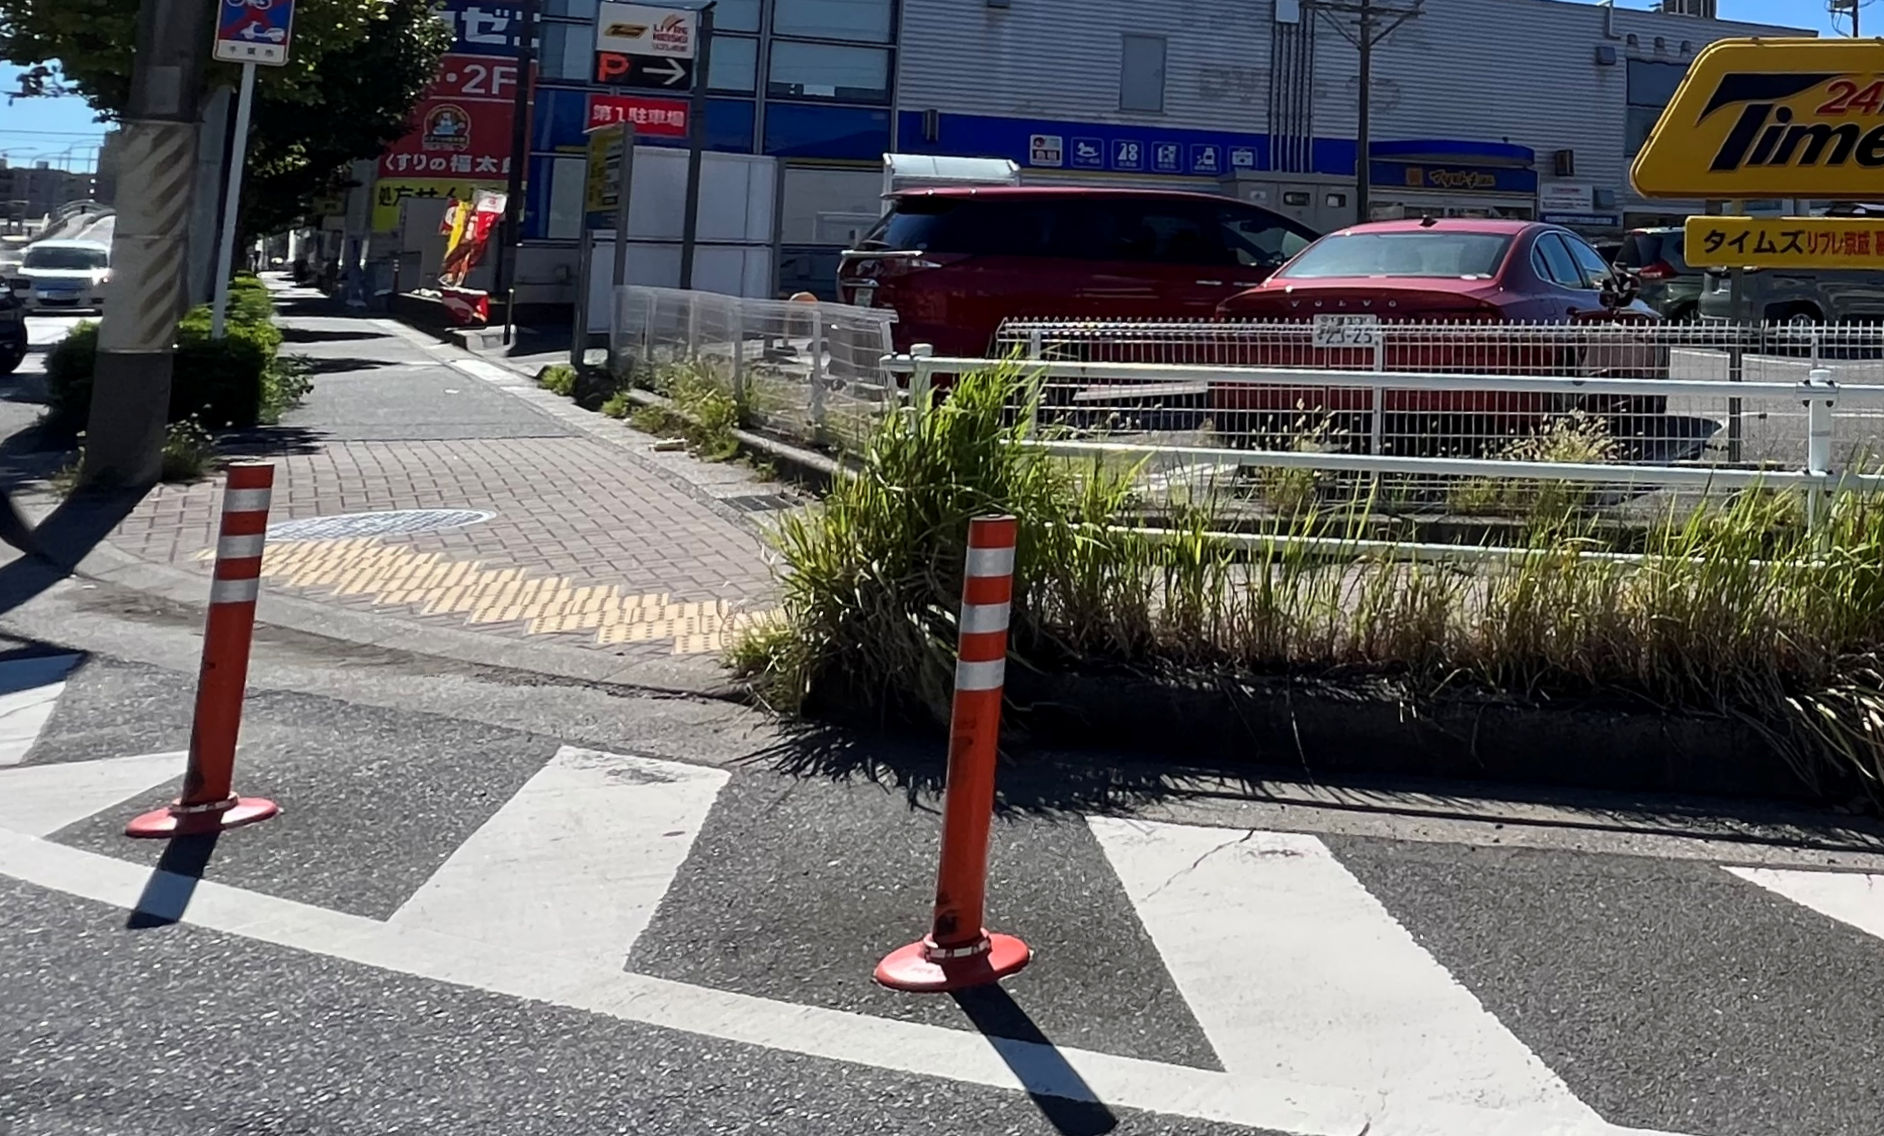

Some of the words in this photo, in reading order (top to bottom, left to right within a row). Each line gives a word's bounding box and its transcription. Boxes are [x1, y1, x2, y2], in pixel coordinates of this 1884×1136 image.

[598, 52, 629, 82] P
[1704, 228, 1804, 255] タイムズ
